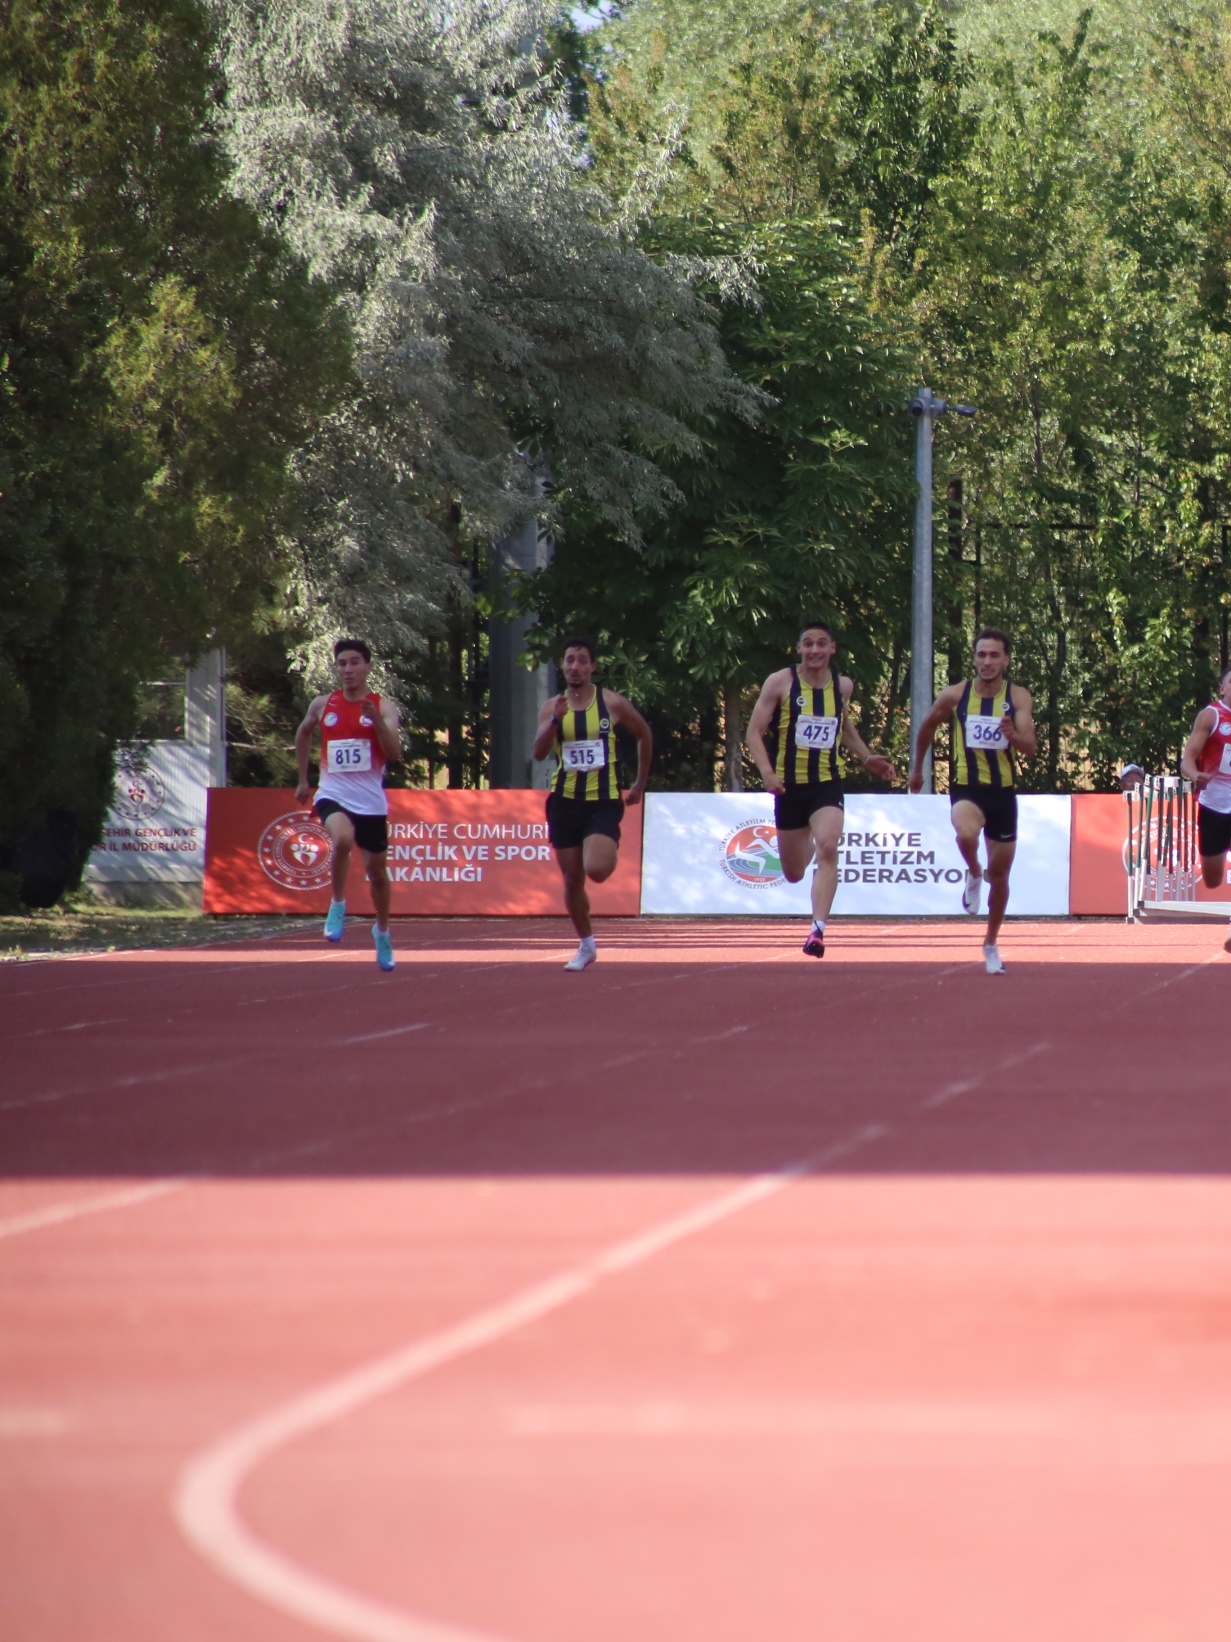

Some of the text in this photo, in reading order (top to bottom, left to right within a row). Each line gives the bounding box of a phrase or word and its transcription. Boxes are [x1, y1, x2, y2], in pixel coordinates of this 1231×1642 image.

[803, 725, 829, 741] 475
[973, 724, 1002, 742] 366
[335, 749, 361, 764] 815
[570, 749, 595, 765] 515
[135, 827, 180, 839] GENÇLİK
[183, 828, 197, 837] VE
[387, 821, 549, 839] RKİYE CUMHURİ
[123, 840, 197, 851] MÜDÜRLÜĞÜ
[838, 832, 922, 847] RKİYE
[386, 842, 551, 864] ENÇLİK VE SPOR
[812, 850, 935, 865] LETİZM
[366, 864, 482, 882] KANLIĞI
